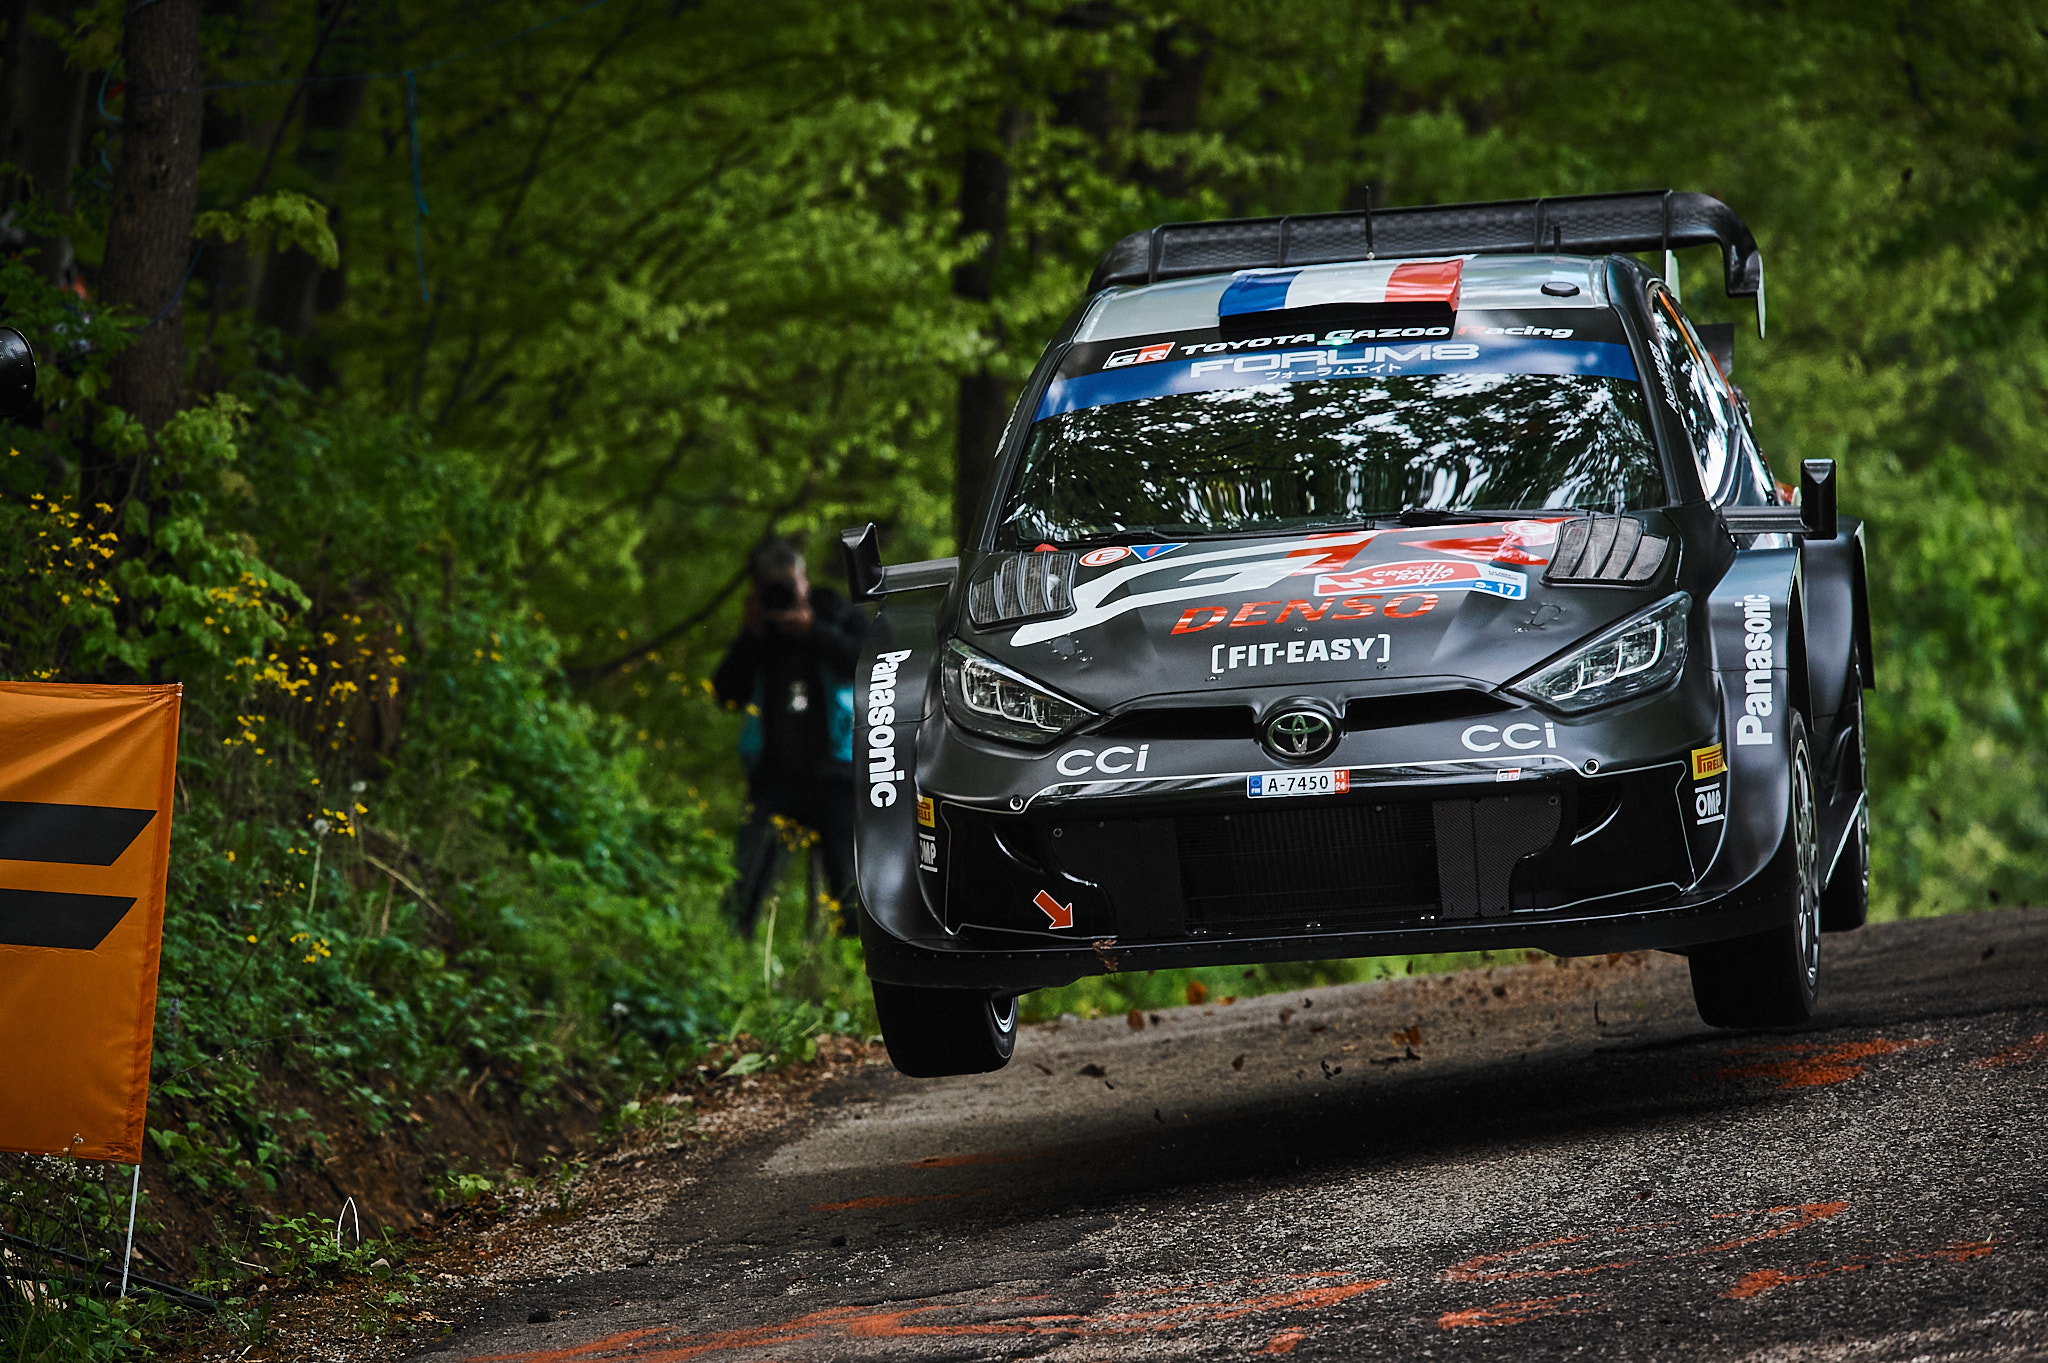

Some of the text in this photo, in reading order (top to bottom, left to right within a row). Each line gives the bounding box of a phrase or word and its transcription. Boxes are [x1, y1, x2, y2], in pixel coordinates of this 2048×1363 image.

[1104, 325, 1574, 368] GR TOYOTA GAZOO Racing
[1191, 343, 1479, 378] FORUM8
[1265, 364, 1402, 382] フォーラムエイト
[1497, 582, 1516, 596] 17
[1170, 593, 1439, 635] DENSO
[1734, 594, 1773, 746] Panasonic
[1268, 775, 1328, 793] A-7450
[1335, 781, 1345, 790] 24
[1696, 789, 1721, 817] OMP
